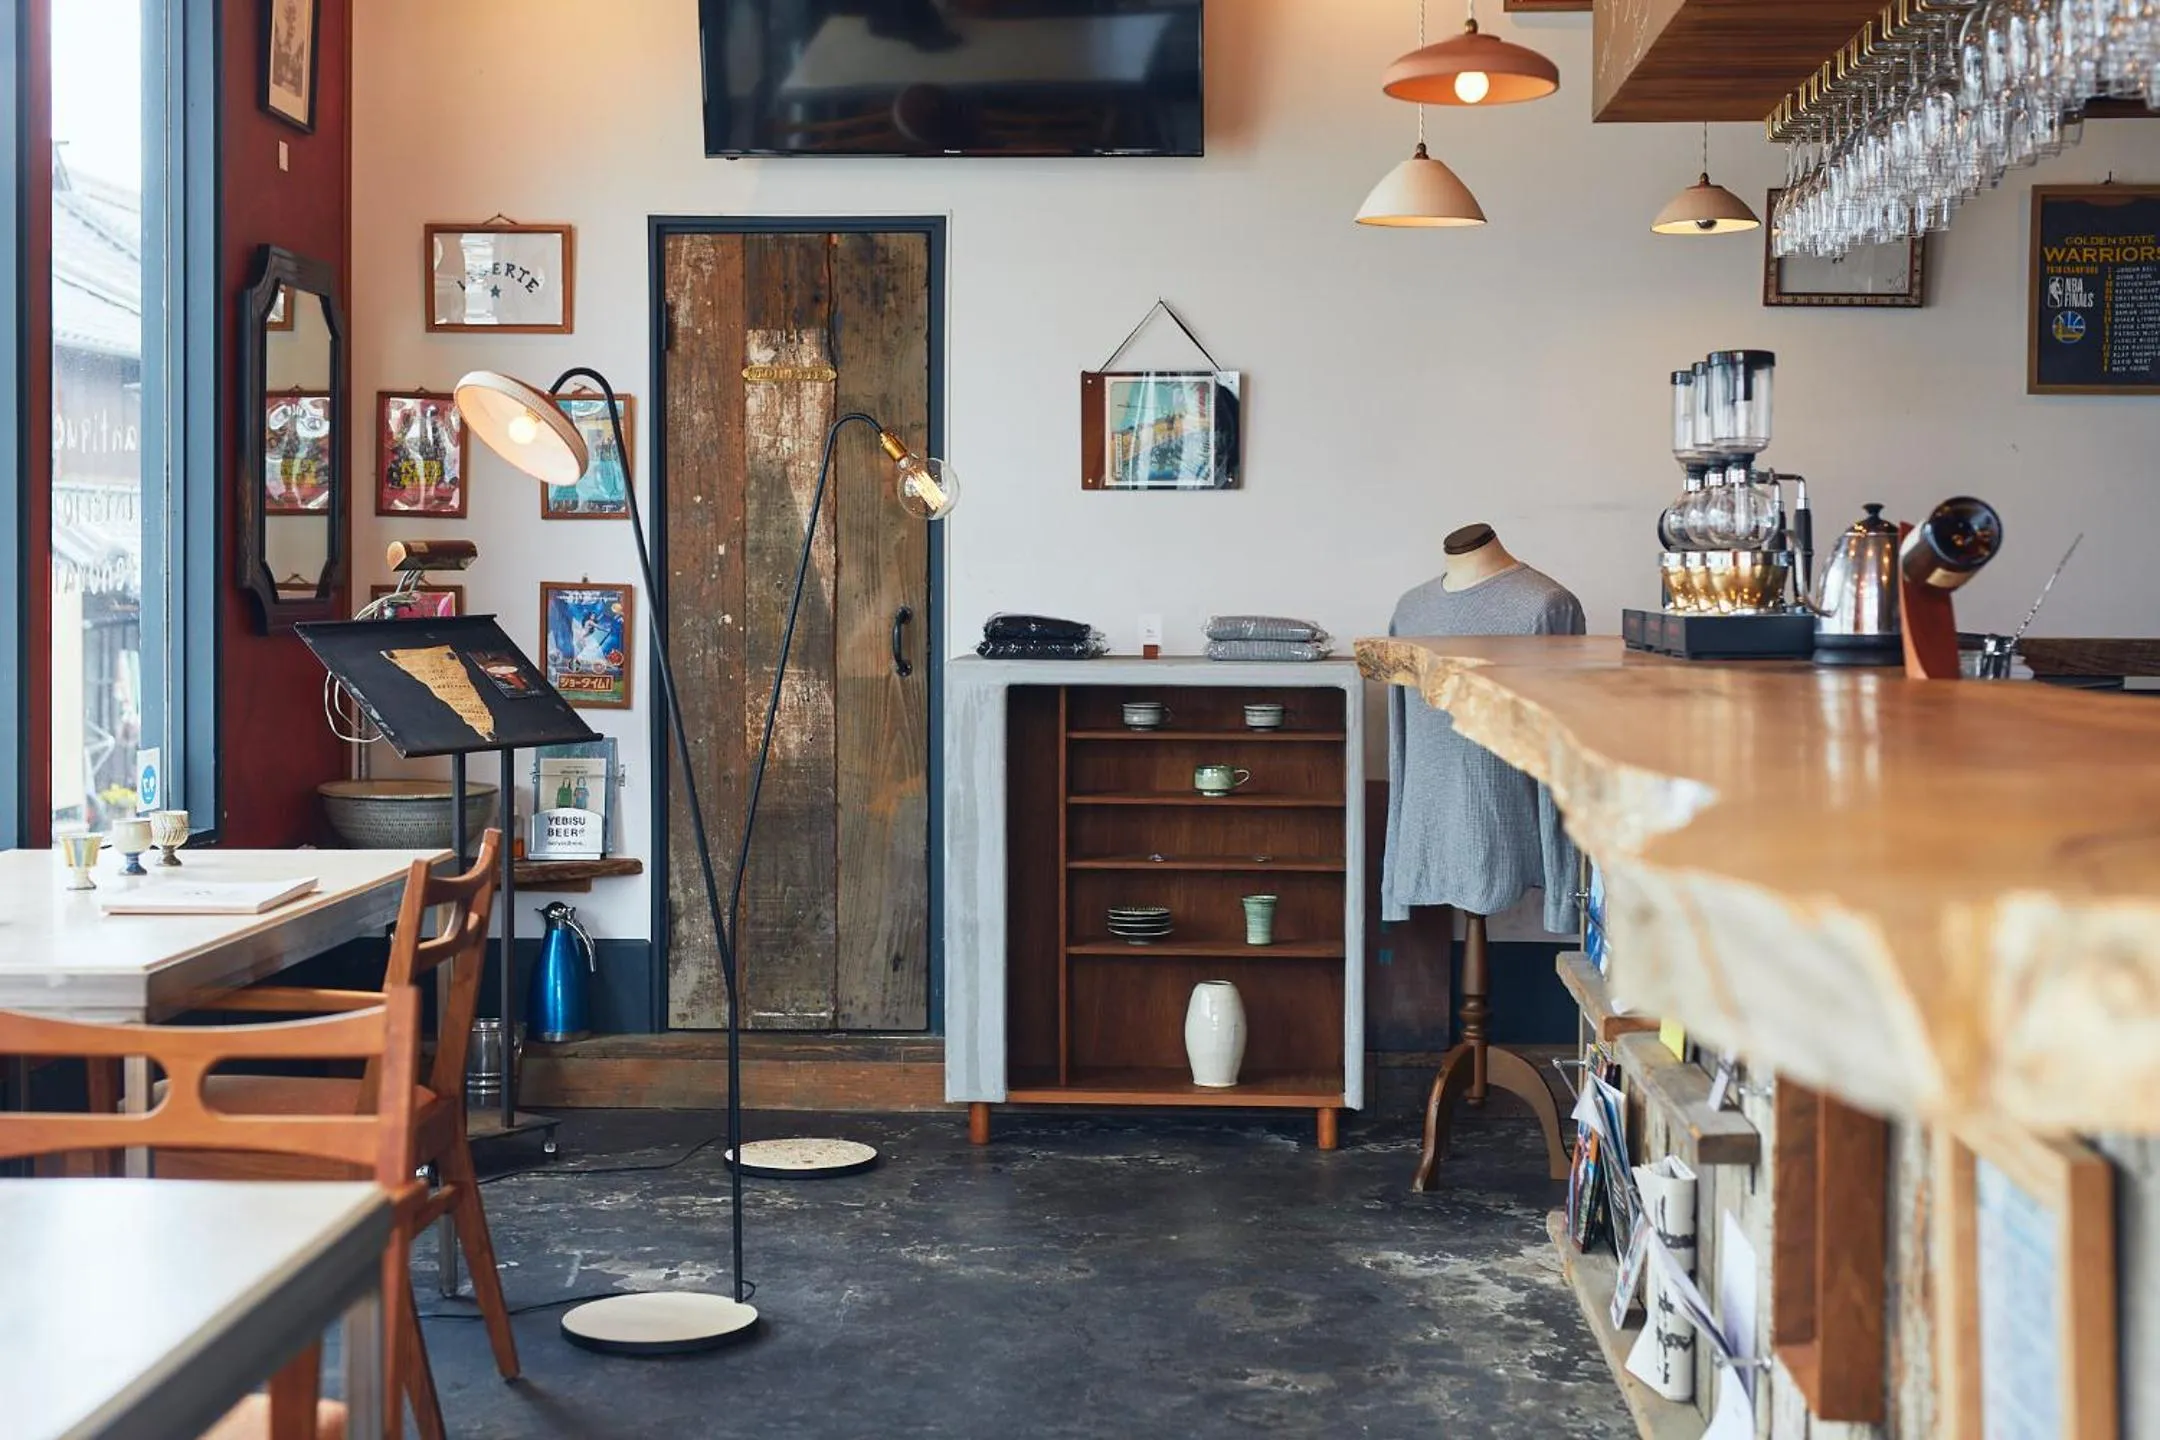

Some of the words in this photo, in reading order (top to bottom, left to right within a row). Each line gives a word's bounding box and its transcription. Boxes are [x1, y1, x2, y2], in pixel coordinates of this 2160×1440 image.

[2065, 236, 2117, 246] GOLDEN
[2119, 235, 2156, 245] STATE
[2064, 277, 2083, 292] NBA
[2064, 292, 2094, 307] FINALS
[547, 815, 586, 826] YEBISU
